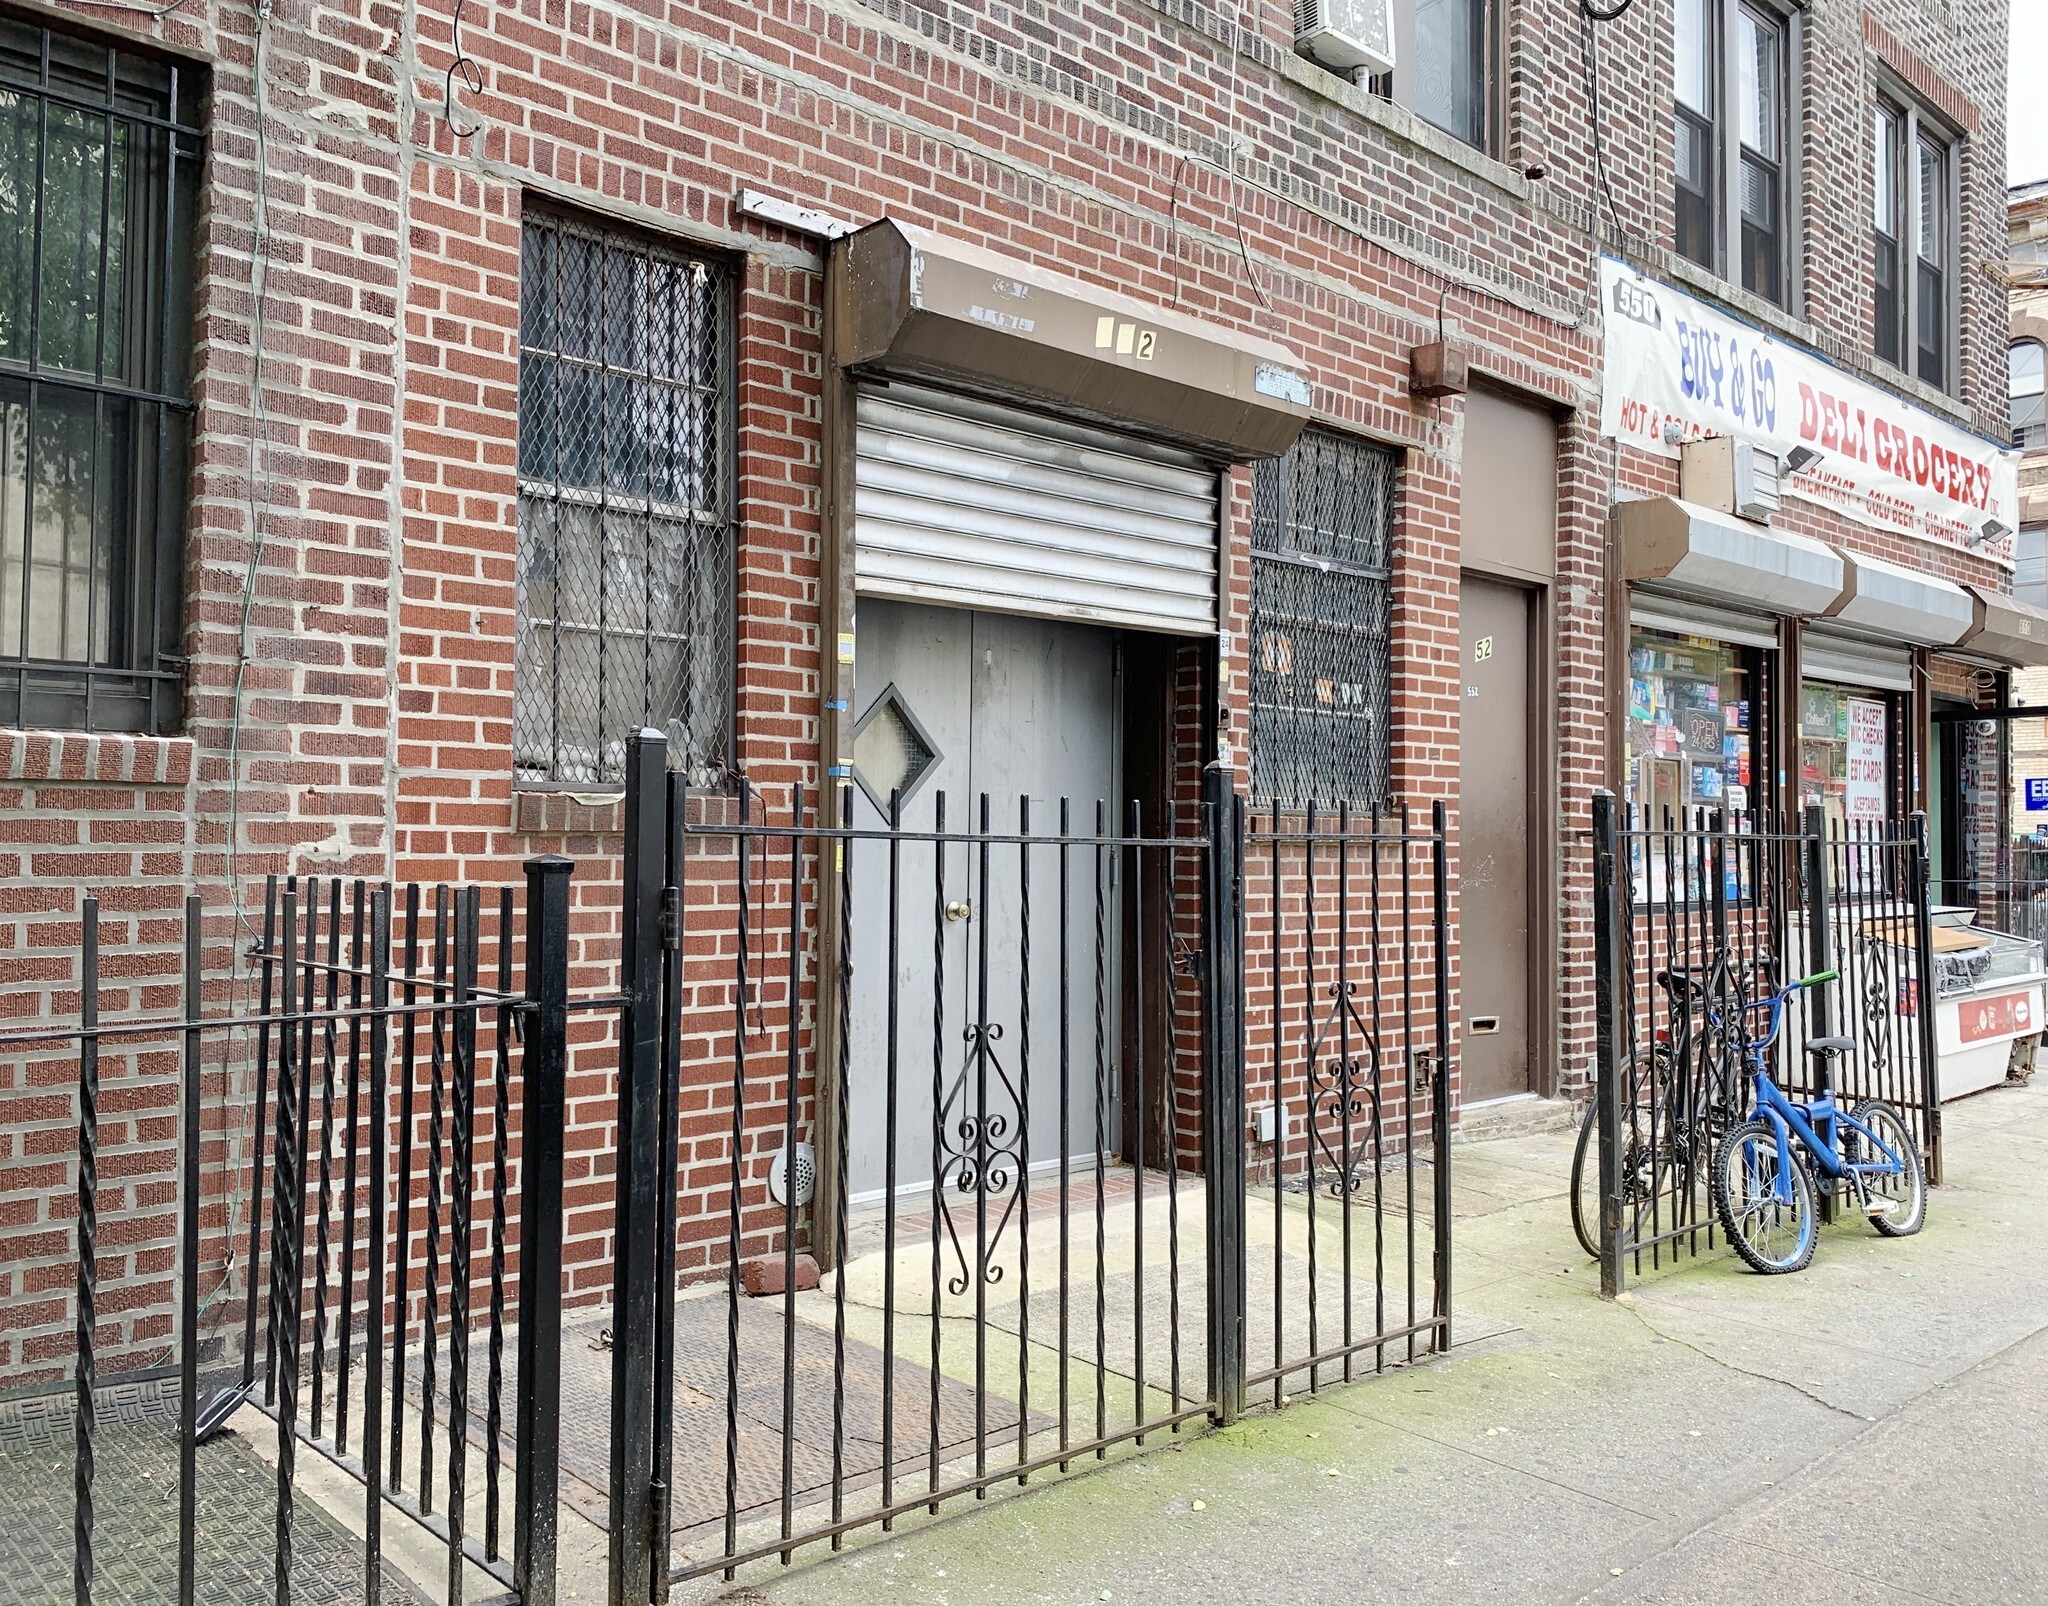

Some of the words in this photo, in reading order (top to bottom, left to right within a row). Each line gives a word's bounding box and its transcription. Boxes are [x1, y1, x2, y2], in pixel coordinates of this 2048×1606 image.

[1618, 281, 1657, 324] 550
[1139, 332, 1153, 359] 2
[1675, 314, 1724, 409] BUY
[1730, 338, 1746, 427] &
[1751, 348, 1776, 433] GO
[1620, 396, 1647, 435] HOT
[1650, 409, 1659, 440] &
[1798, 381, 1868, 463] DELI
[1873, 417, 1992, 511] GROCERY
[1476, 639, 1491, 659] 52
[1852, 705, 1861, 723] WE
[1862, 706, 1882, 726] ACCEPT
[1691, 719, 1719, 738] OPEN
[1850, 725, 1861, 743] WIC
[1862, 726, 1883, 746] CHECKS
[1691, 735, 1700, 748] 24
[1862, 748, 1872, 756] AND
[1850, 758, 1861, 781] EBT
[1862, 760, 1882, 783] CARDS
